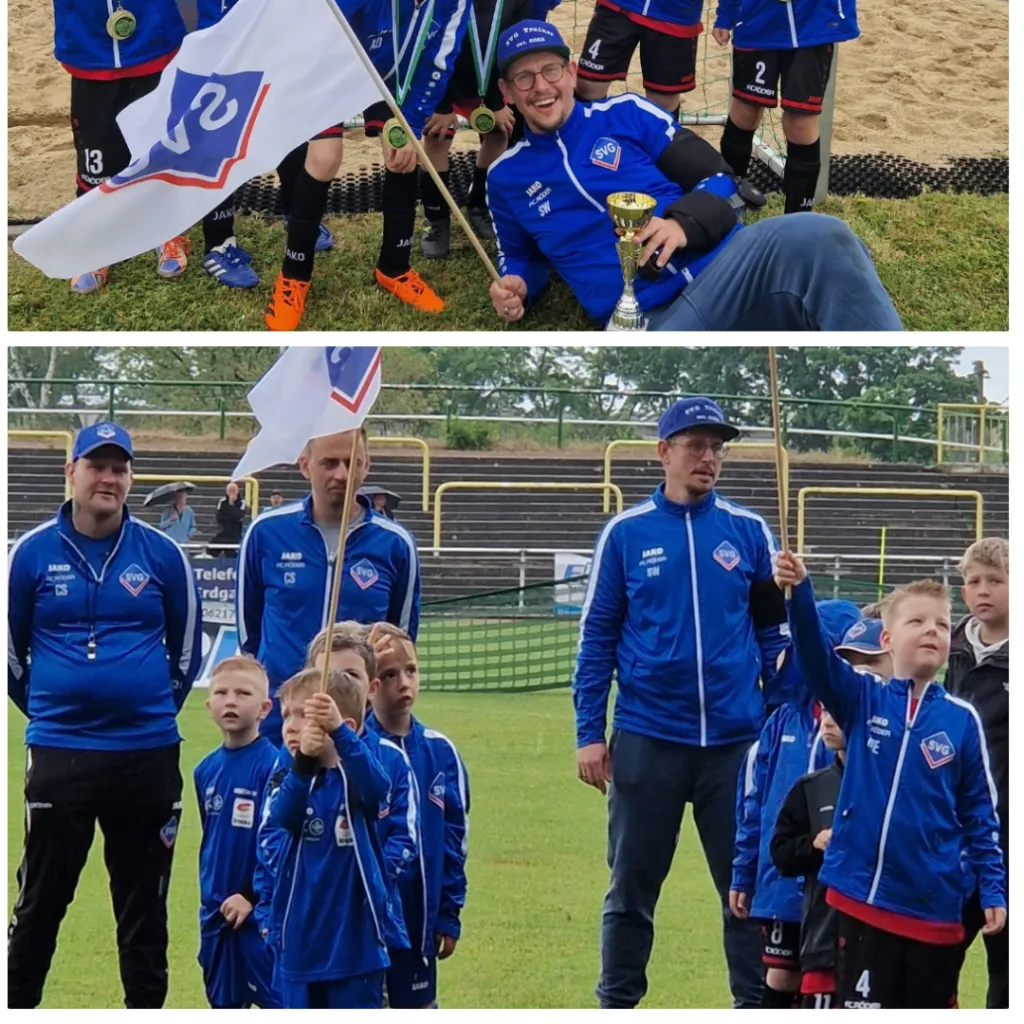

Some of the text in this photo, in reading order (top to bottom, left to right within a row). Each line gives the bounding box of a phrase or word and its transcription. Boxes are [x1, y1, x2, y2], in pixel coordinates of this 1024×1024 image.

[505, 31, 520, 47] SVG
[588, 39, 602, 60] 4
[755, 60, 766, 85] 2
[594, 142, 616, 159] SVG
[84, 147, 103, 174] 13
[525, 180, 542, 198] JAKO
[538, 200, 551, 217] SW
[280, 552, 302, 560] JAKO
[642, 547, 664, 557] JAKO
[719, 549, 736, 560] SVG
[48, 564, 70, 572] JAKO
[356, 565, 375, 578] SVG
[647, 566, 660, 578] SW
[125, 571, 144, 583] SVG
[928, 739, 950, 756] SVG
[855, 969, 871, 998] 4
